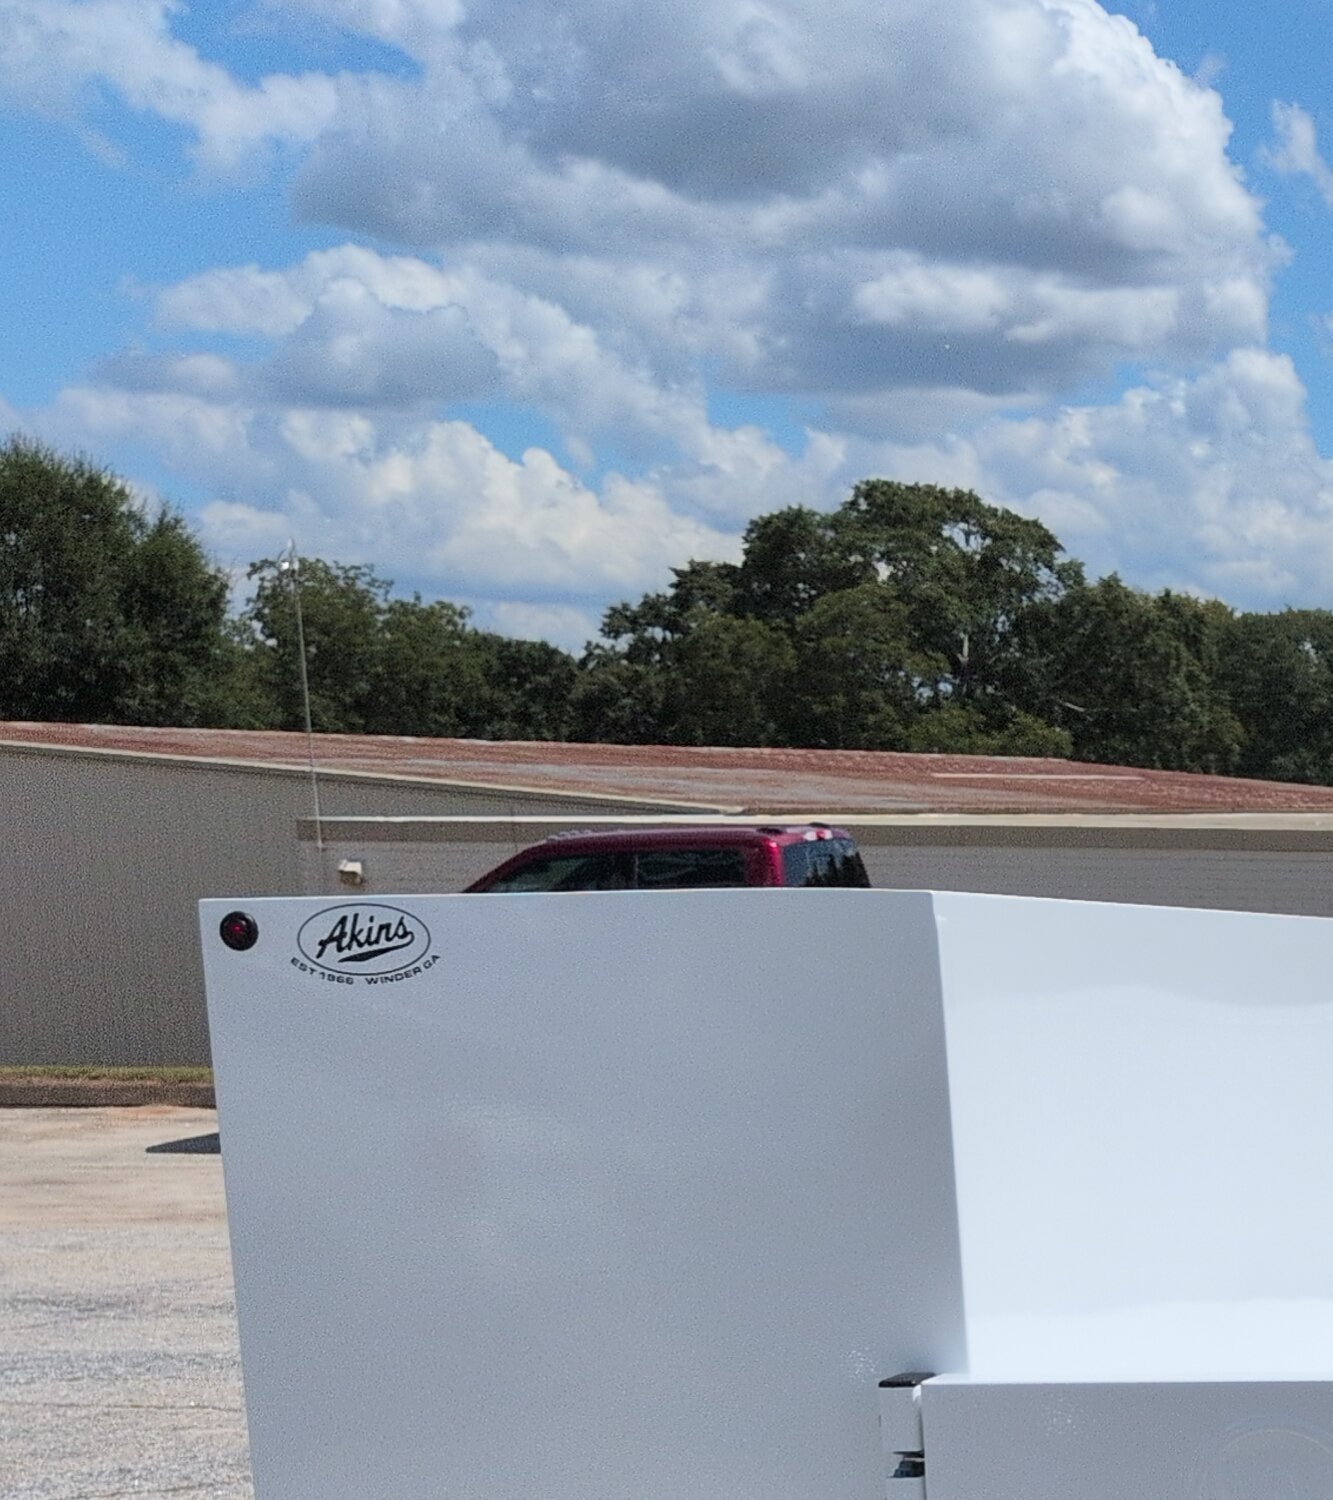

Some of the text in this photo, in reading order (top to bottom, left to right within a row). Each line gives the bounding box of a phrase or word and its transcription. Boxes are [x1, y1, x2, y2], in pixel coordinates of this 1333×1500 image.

[315, 913, 415, 962] Akins
[290, 957, 317, 975] EST
[365, 966, 422, 985] WINDER
[423, 954, 441, 969] GA
